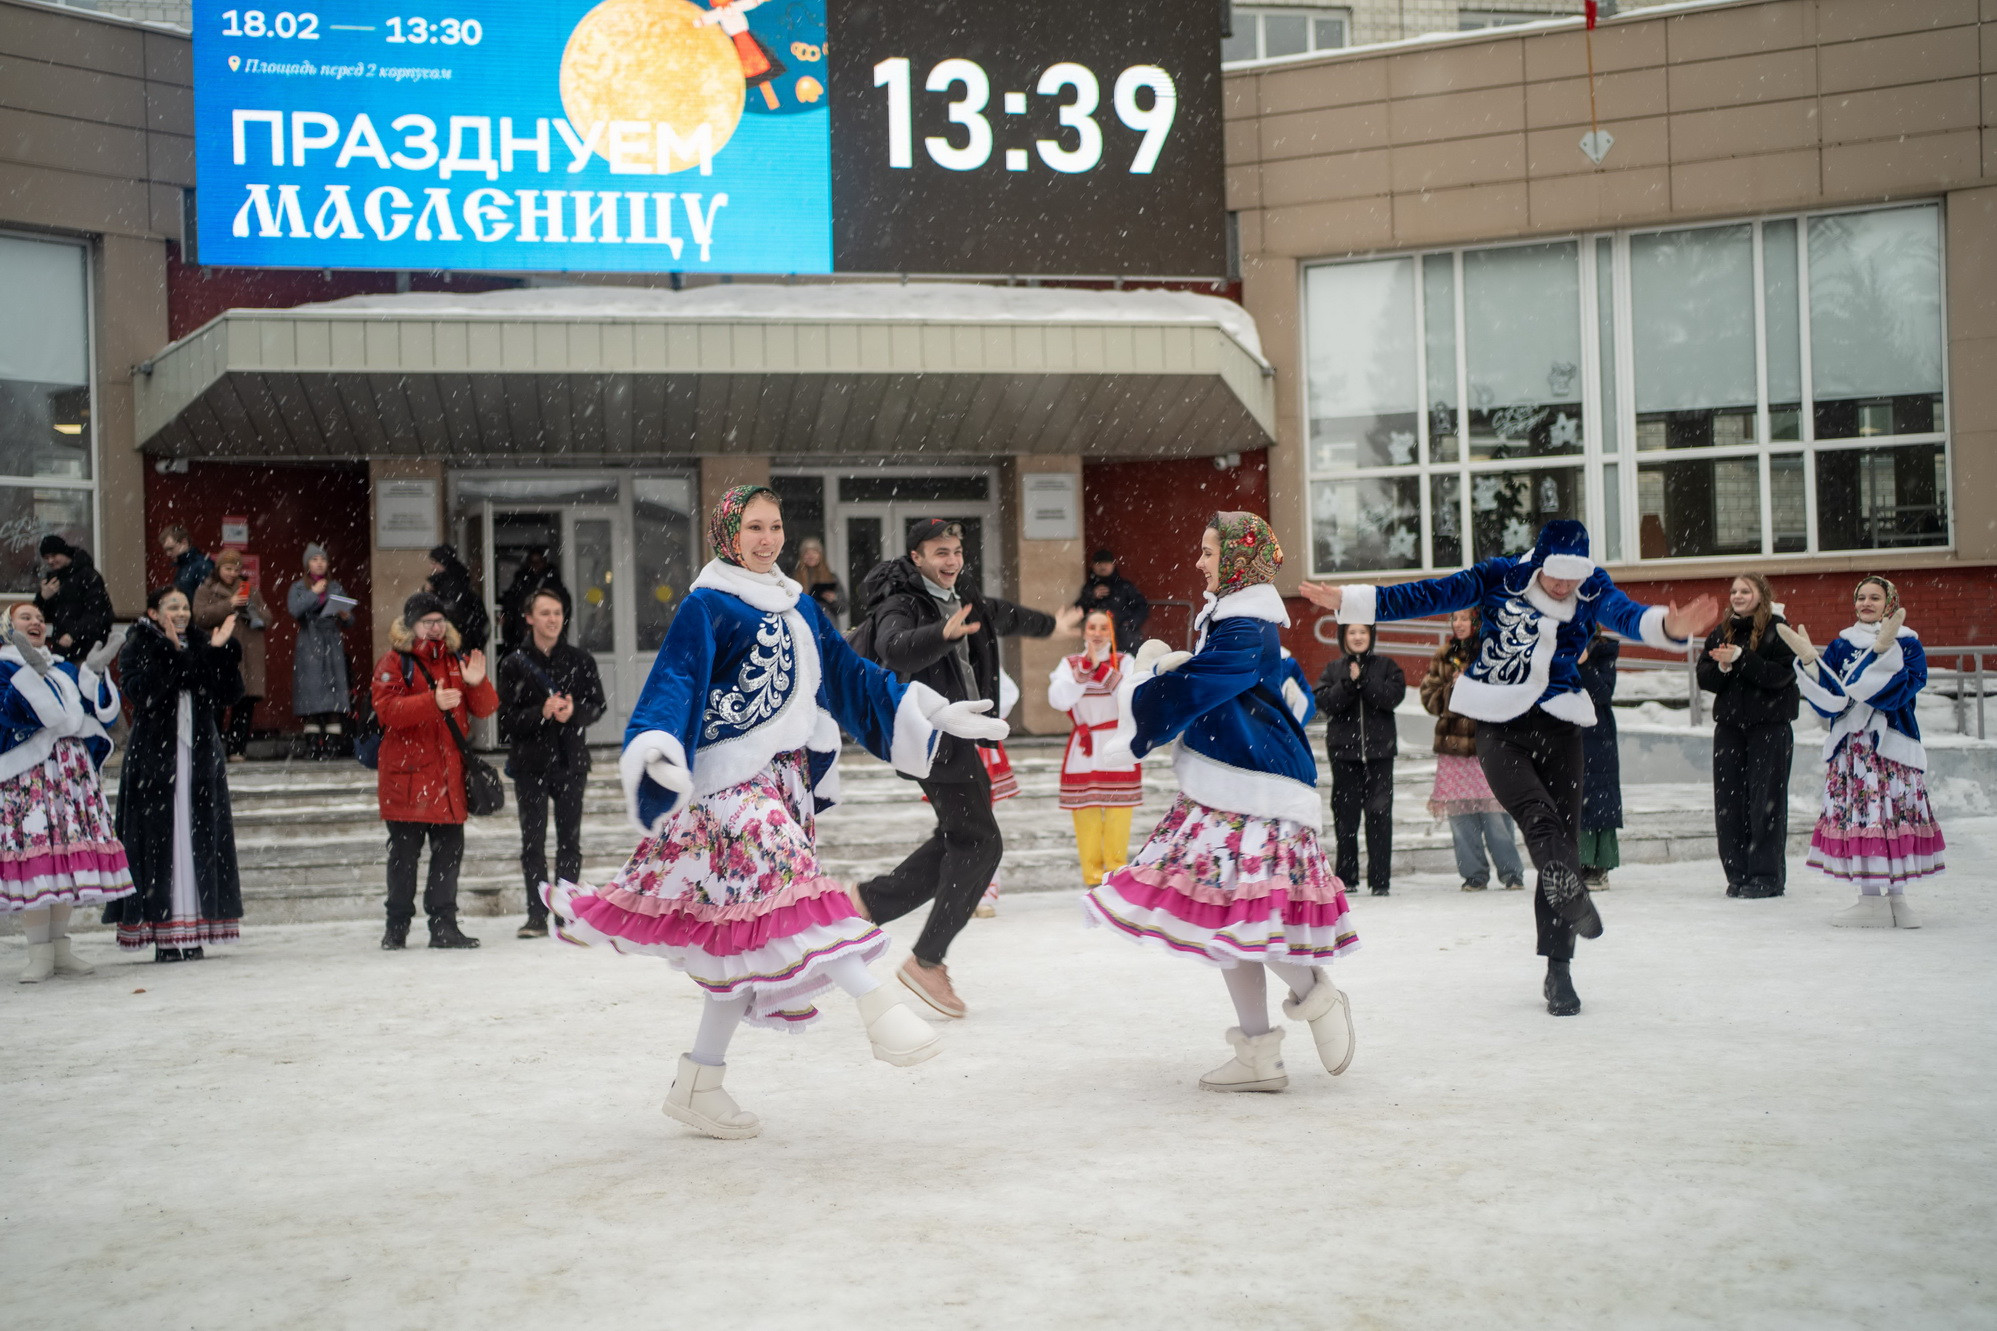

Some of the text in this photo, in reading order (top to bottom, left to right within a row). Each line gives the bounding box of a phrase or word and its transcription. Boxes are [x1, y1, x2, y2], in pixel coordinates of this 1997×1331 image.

[221, 9, 320, 40] 18.02
[385, 16, 483, 46] 13:30
[244, 58, 452, 82] Площадь перед 2 корпусом
[231, 108, 713, 181] ПРАЗДНУЕМ
[872, 57, 1178, 174] 13:39
[231, 183, 730, 263] МАСЛЕНИЦУ
